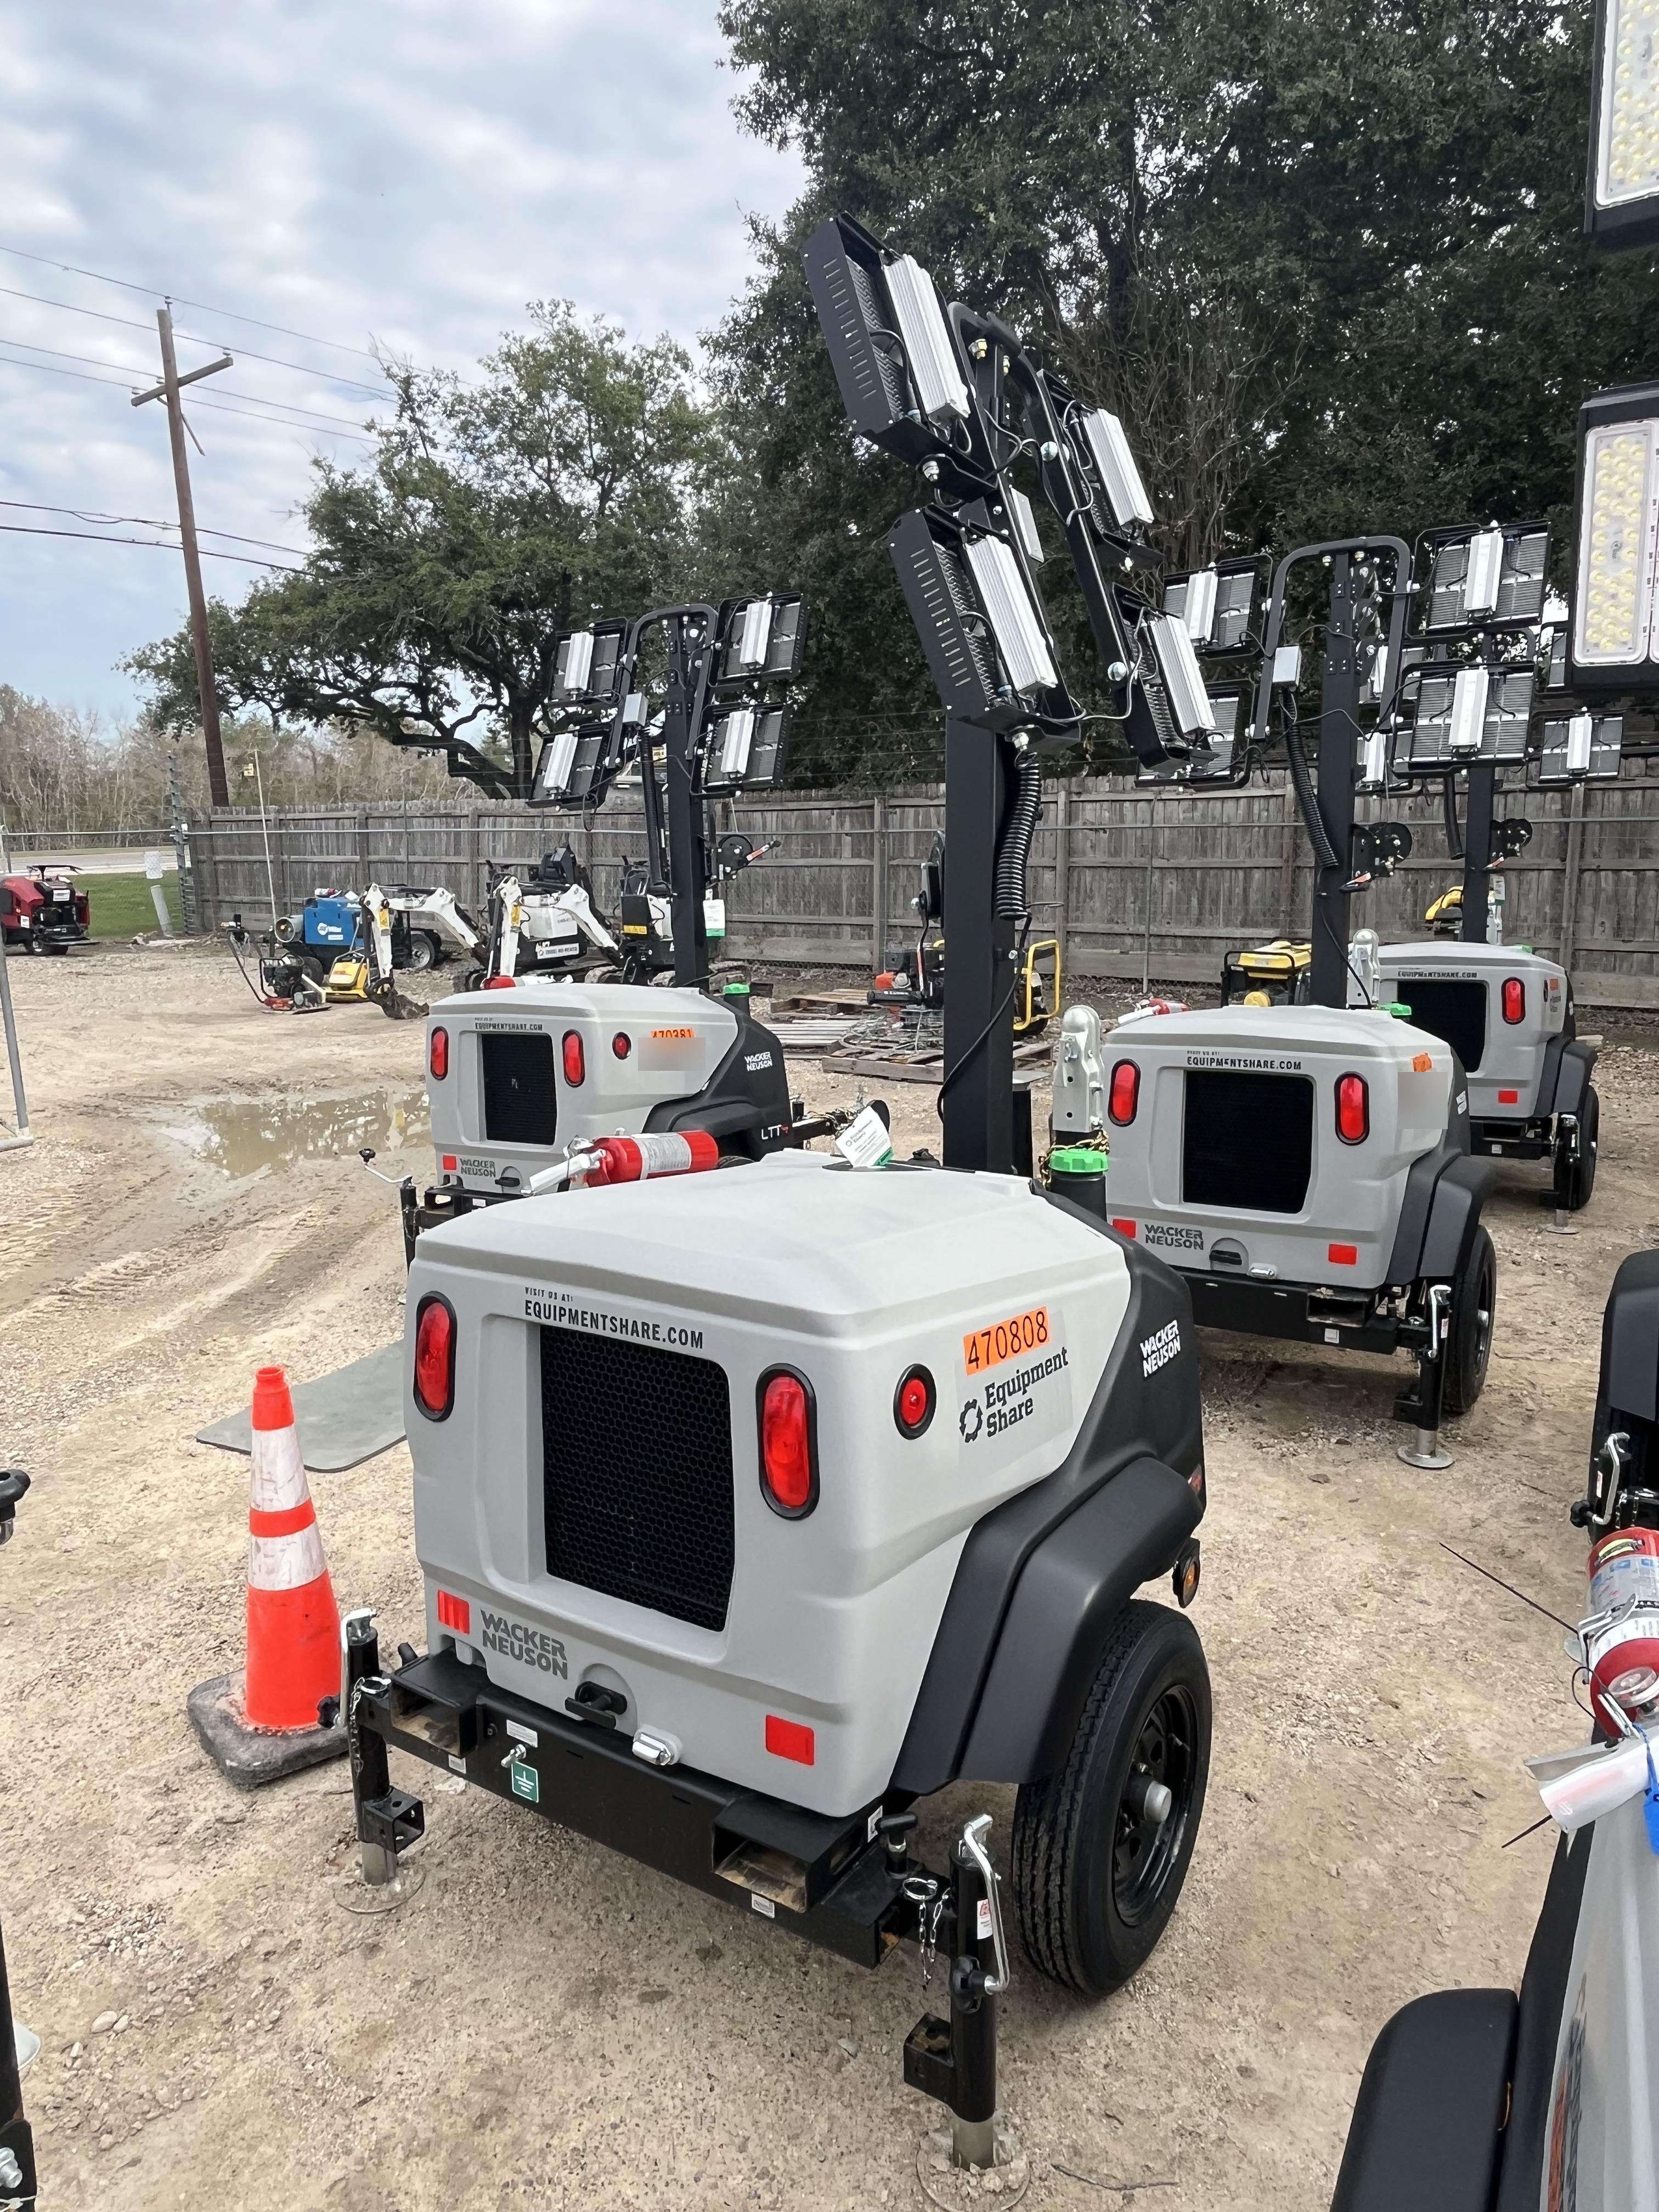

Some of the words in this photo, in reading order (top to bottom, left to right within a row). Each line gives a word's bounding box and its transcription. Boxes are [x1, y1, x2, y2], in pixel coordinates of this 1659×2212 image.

[1187, 1056, 1301, 1070] EQUIPMENTSHARE.COM
[1144, 1224, 1203, 1240] WACKER
[1146, 1234, 1204, 1250] NEUSON
[525, 1300, 703, 1349] EQUIPMENTSHARE.COM
[968, 1311, 1047, 1369] 470808
[1140, 1319, 1178, 1358] WACKER
[985, 1346, 1069, 1410] Equipment
[1143, 1335, 1181, 1378] NEUSON
[987, 1398, 1034, 1437] Share
[480, 1608, 567, 1662] WACKER
[482, 1629, 568, 1680] NEUSON
